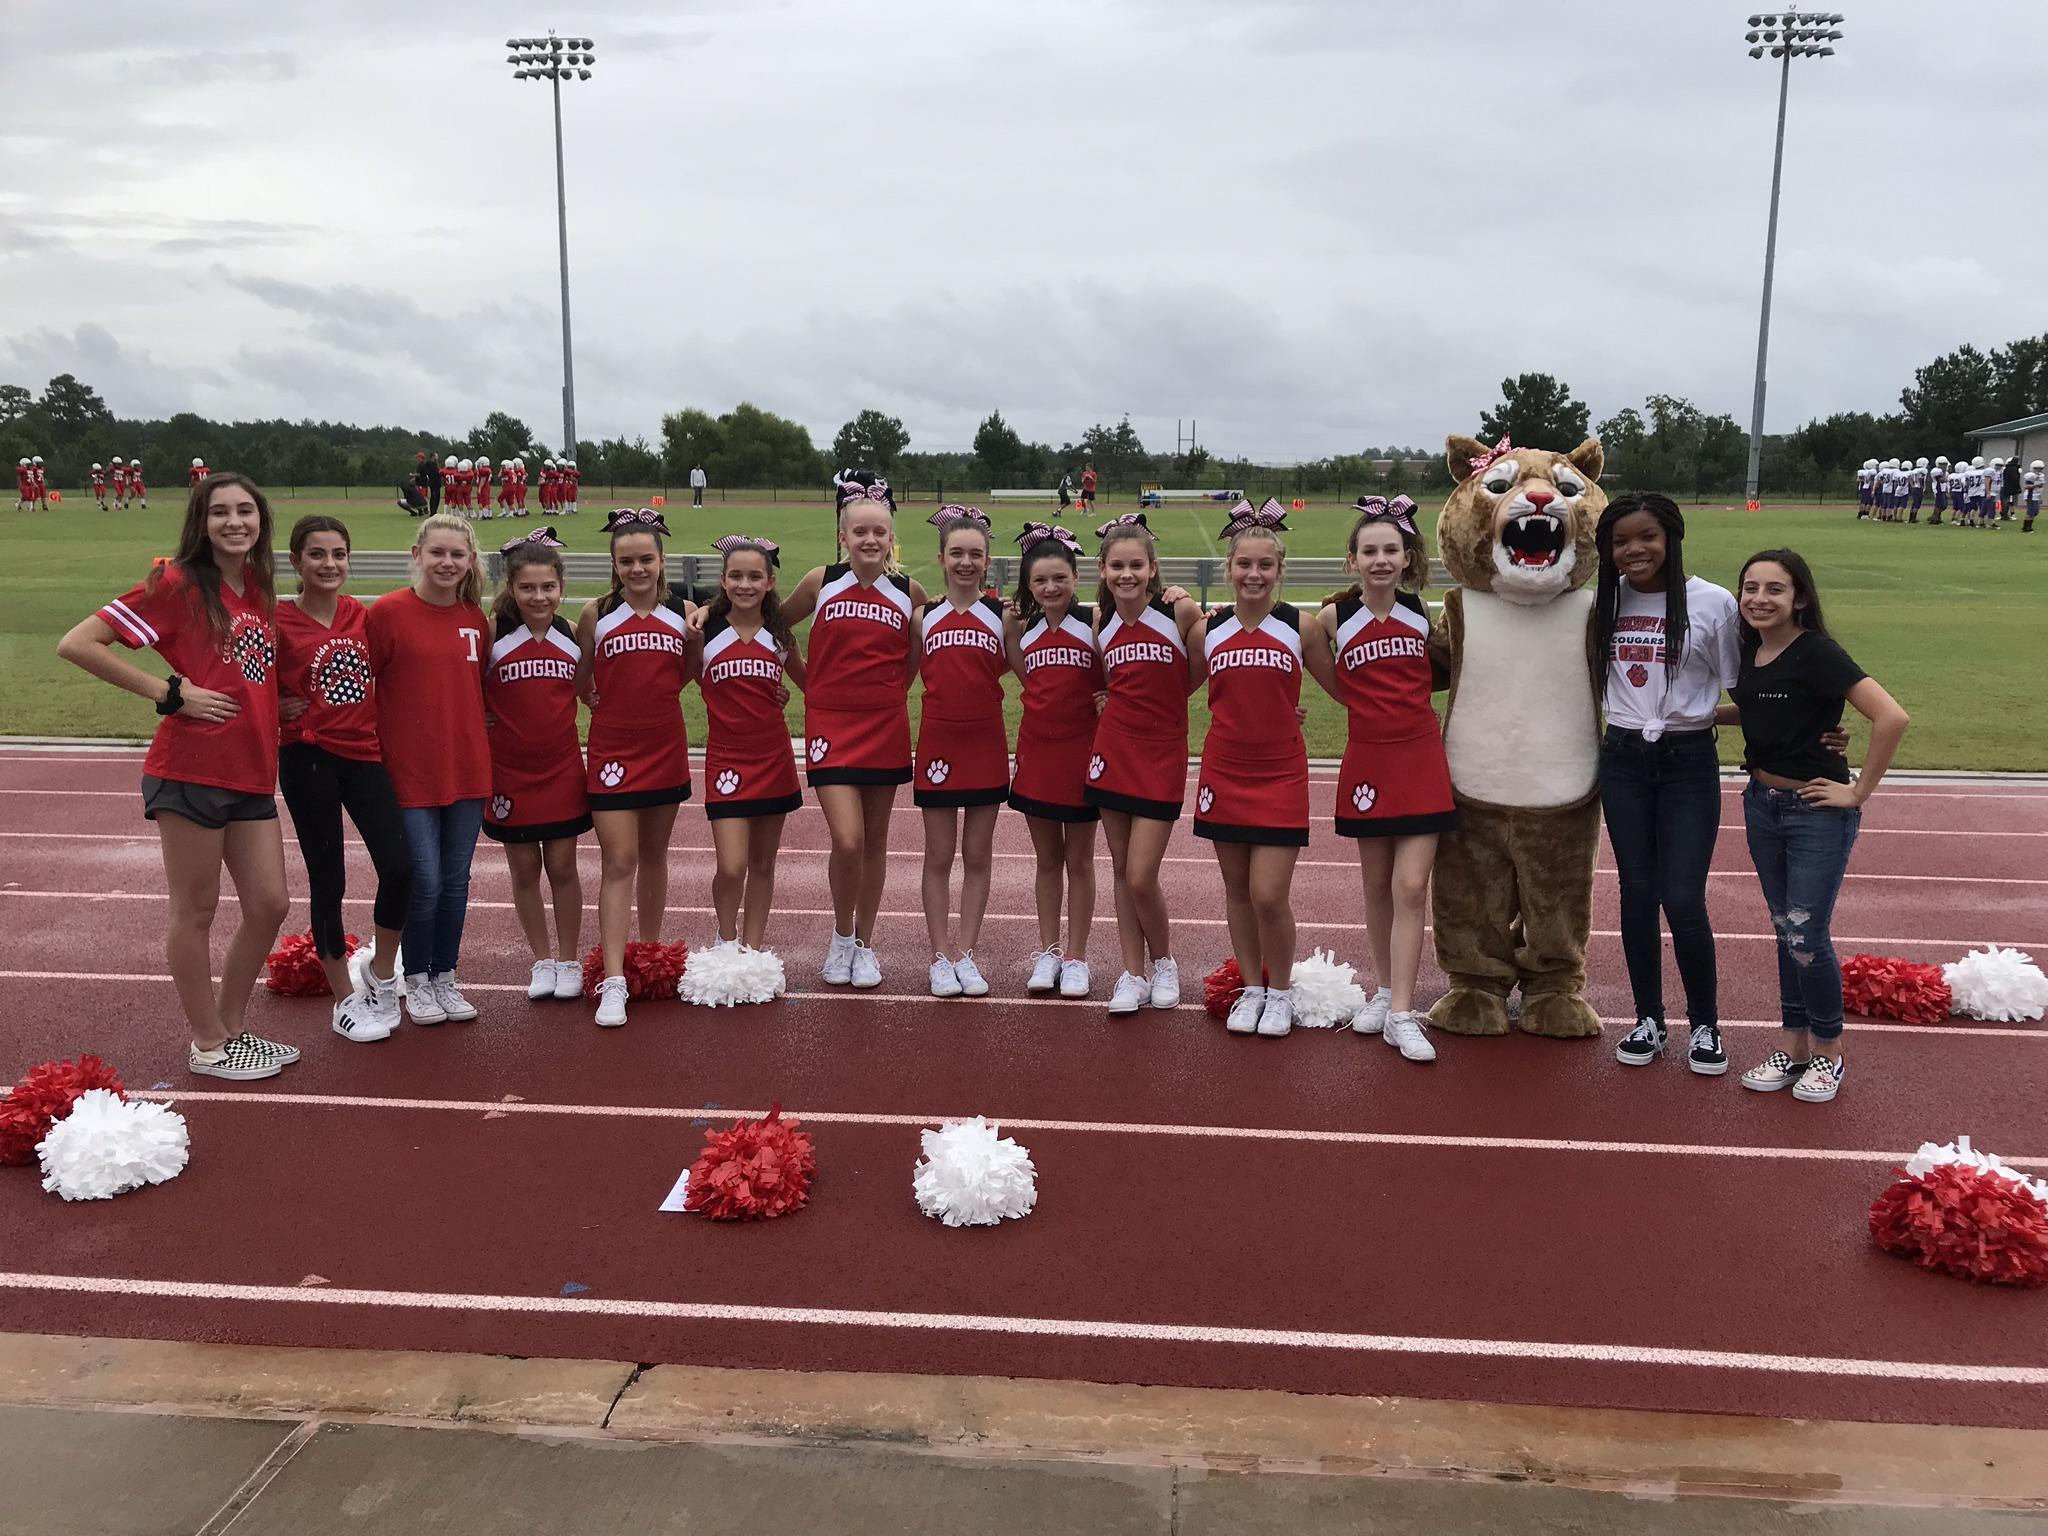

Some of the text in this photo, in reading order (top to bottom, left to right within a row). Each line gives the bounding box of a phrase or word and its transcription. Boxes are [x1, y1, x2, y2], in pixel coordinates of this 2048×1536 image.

[242, 612, 261, 624] Park
[825, 600, 902, 629] COUGARS
[330, 637, 354, 647] Park
[458, 627, 481, 662] T
[604, 632, 683, 658] COUGARS
[926, 629, 998, 656] COUGARS
[1612, 636, 1665, 645] COUGARS
[1210, 649, 1293, 673] COUGARS
[1345, 637, 1425, 671] COUGARS
[499, 659, 576, 684] COUGARS
[710, 659, 782, 684] COUGARS
